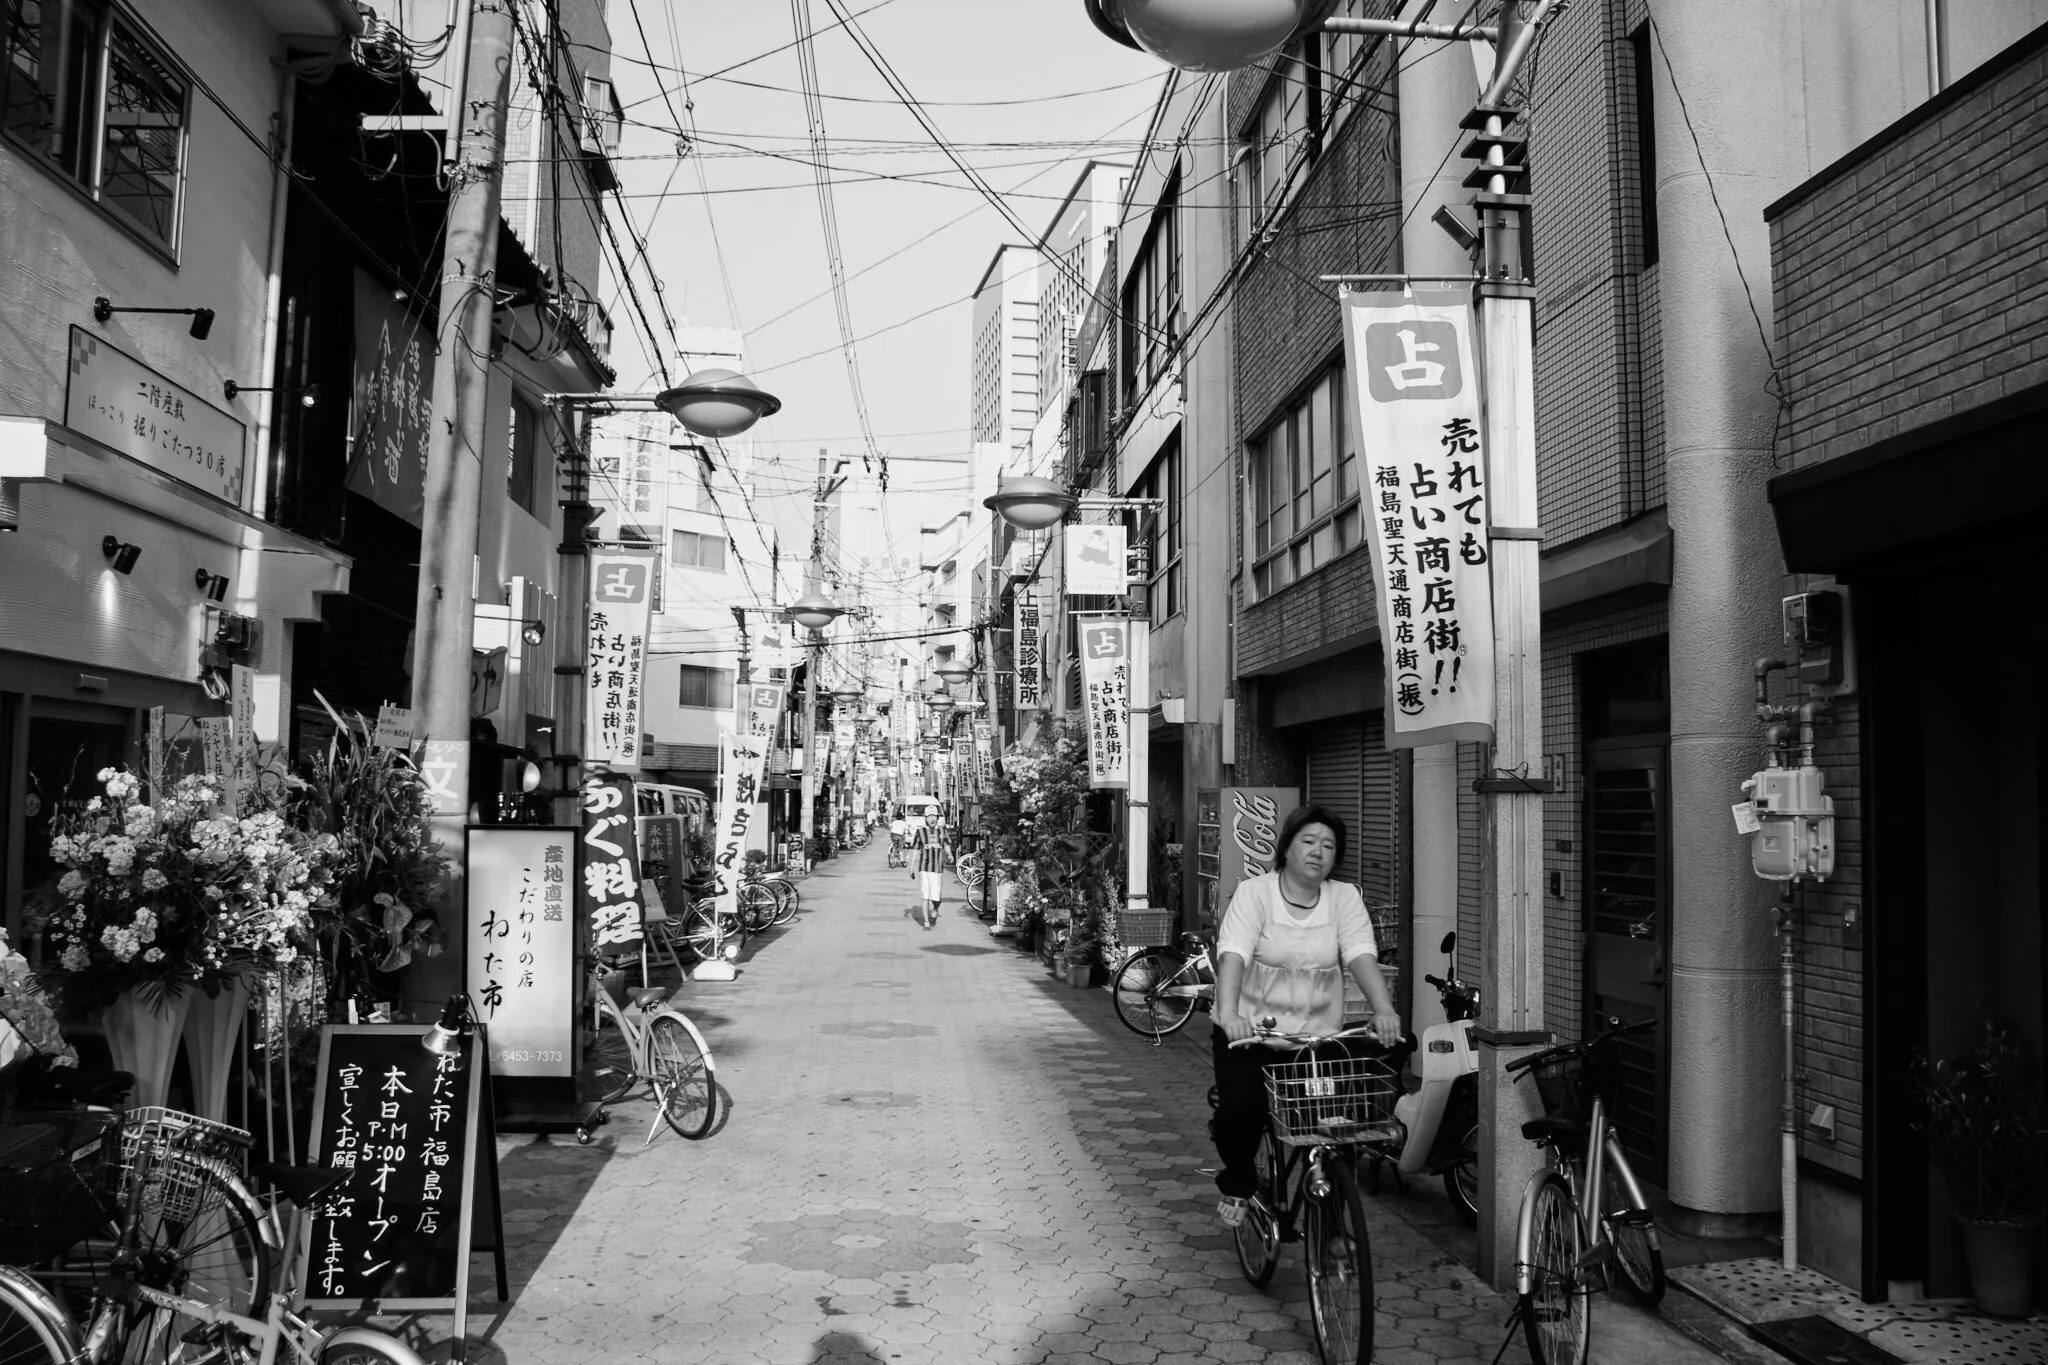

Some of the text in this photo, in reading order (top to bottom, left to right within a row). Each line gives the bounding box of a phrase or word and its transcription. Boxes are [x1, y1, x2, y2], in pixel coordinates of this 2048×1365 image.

[1384, 328, 1446, 390] 占
[136, 381, 186, 423] 二階座敷
[1441, 417, 1487, 567] 売れても
[1374, 465, 1426, 717] 福島聖天通商店街(振)
[1018, 588, 1040, 705] 上福島診療所
[1093, 630, 1119, 656] 占
[1113, 665, 1128, 725] 売れても
[417, 755, 459, 800] 文
[543, 844, 564, 922] 産地直送
[582, 778, 645, 946] ふぐ料理
[479, 909, 510, 1021] ねた市
[517, 867, 538, 989] こだわりの店
[502, 1050, 563, 1063] 6453-7373
